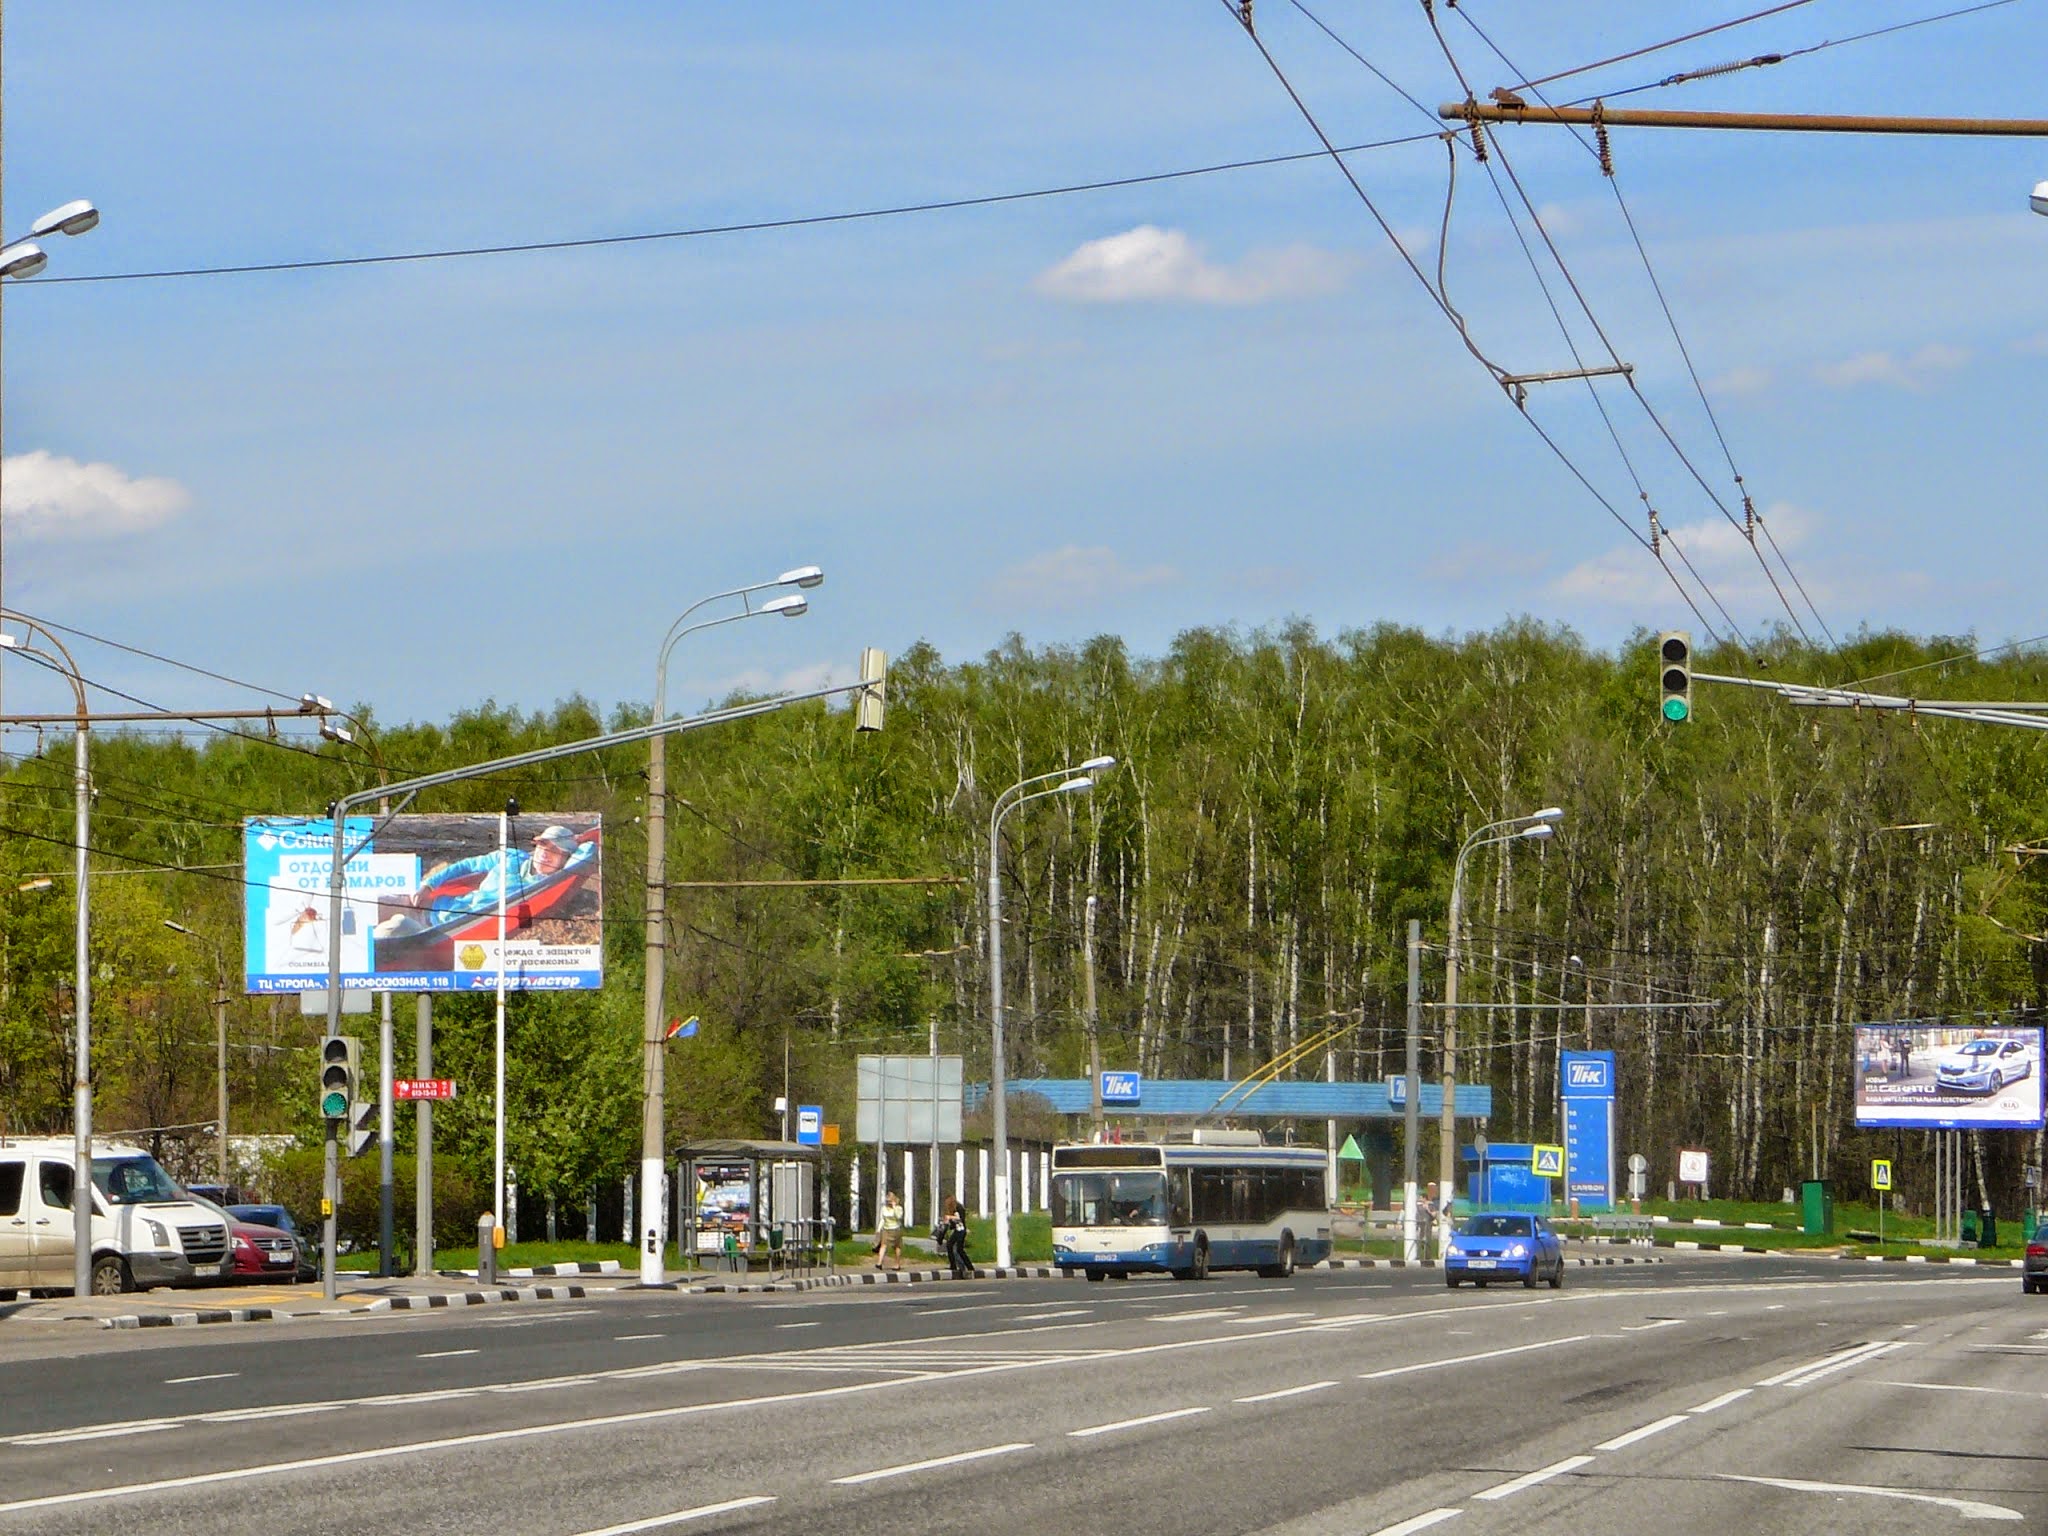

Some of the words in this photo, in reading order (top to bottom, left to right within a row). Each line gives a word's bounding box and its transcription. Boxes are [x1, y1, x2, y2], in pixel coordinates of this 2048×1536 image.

[288, 860, 369, 874] ОТДОНИ
[298, 877, 319, 888] ОТ
[545, 947, 591, 957] защитой
[521, 958, 579, 966] насекомых
[258, 979, 273, 990] ТЦ
[344, 977, 430, 989] ПРОФСОЮЗНАЯ,
